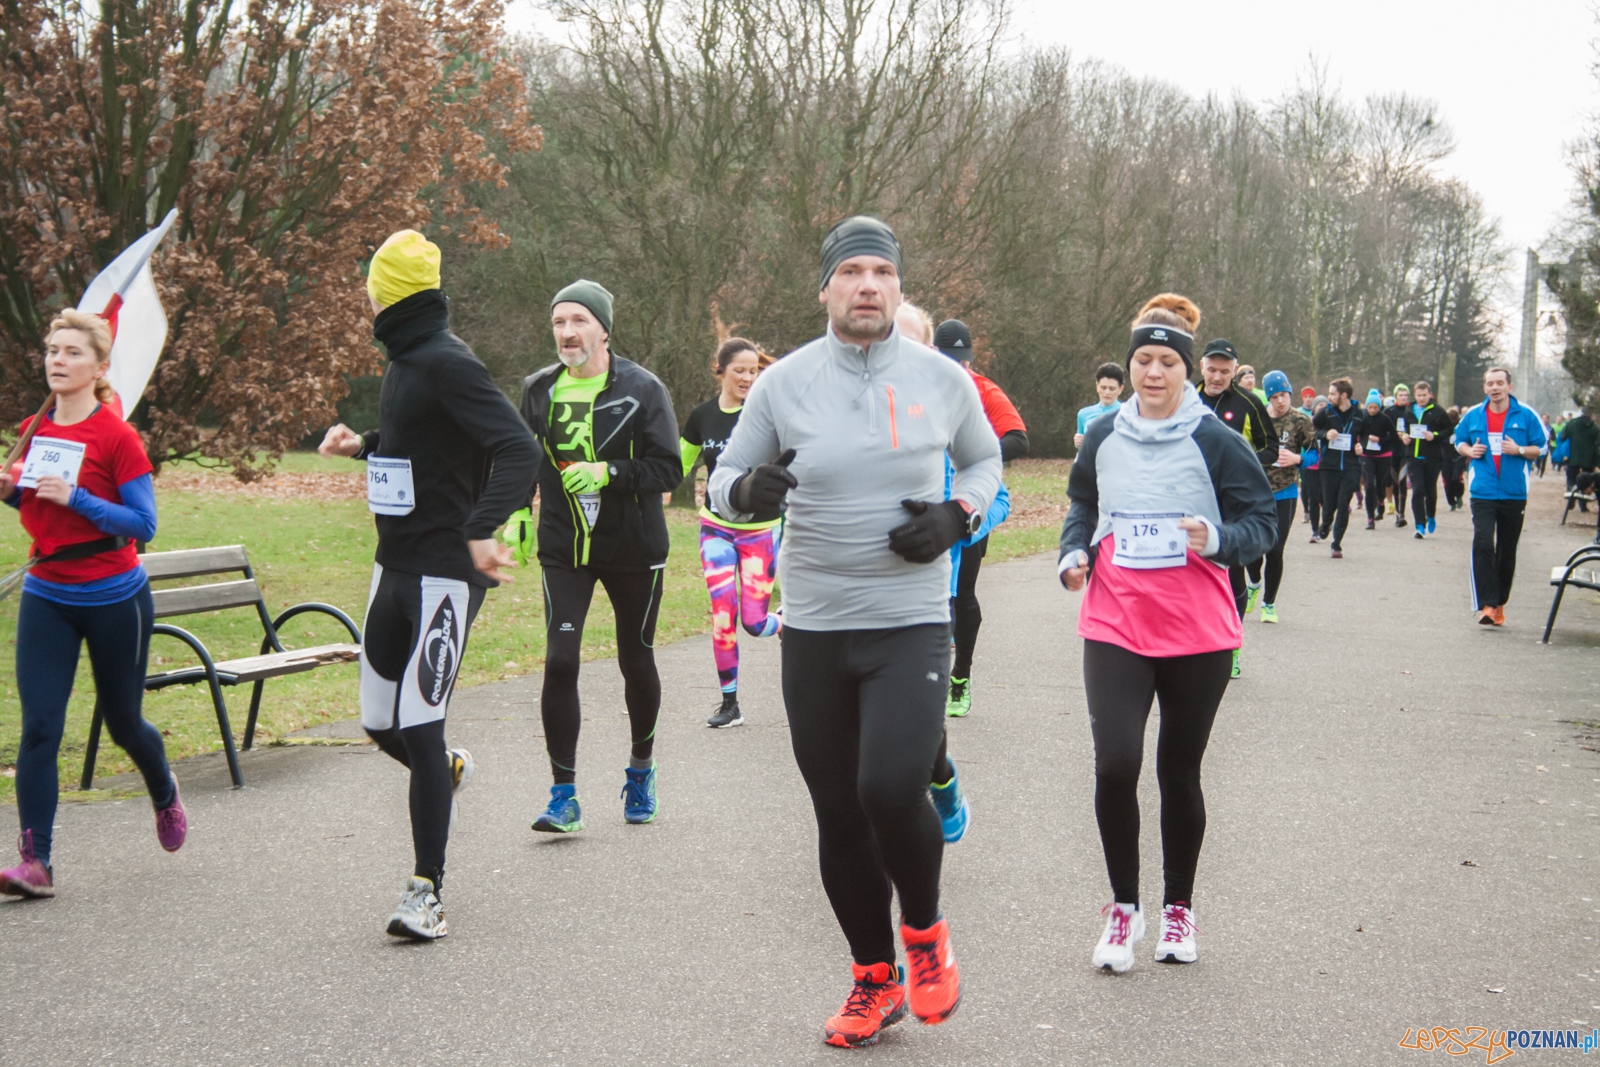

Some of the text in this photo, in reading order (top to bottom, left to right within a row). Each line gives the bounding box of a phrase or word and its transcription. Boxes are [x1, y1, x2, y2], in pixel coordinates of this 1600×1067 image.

[41, 450, 60, 463] 260
[370, 471, 388, 484] 764
[1132, 523, 1159, 537] 176
